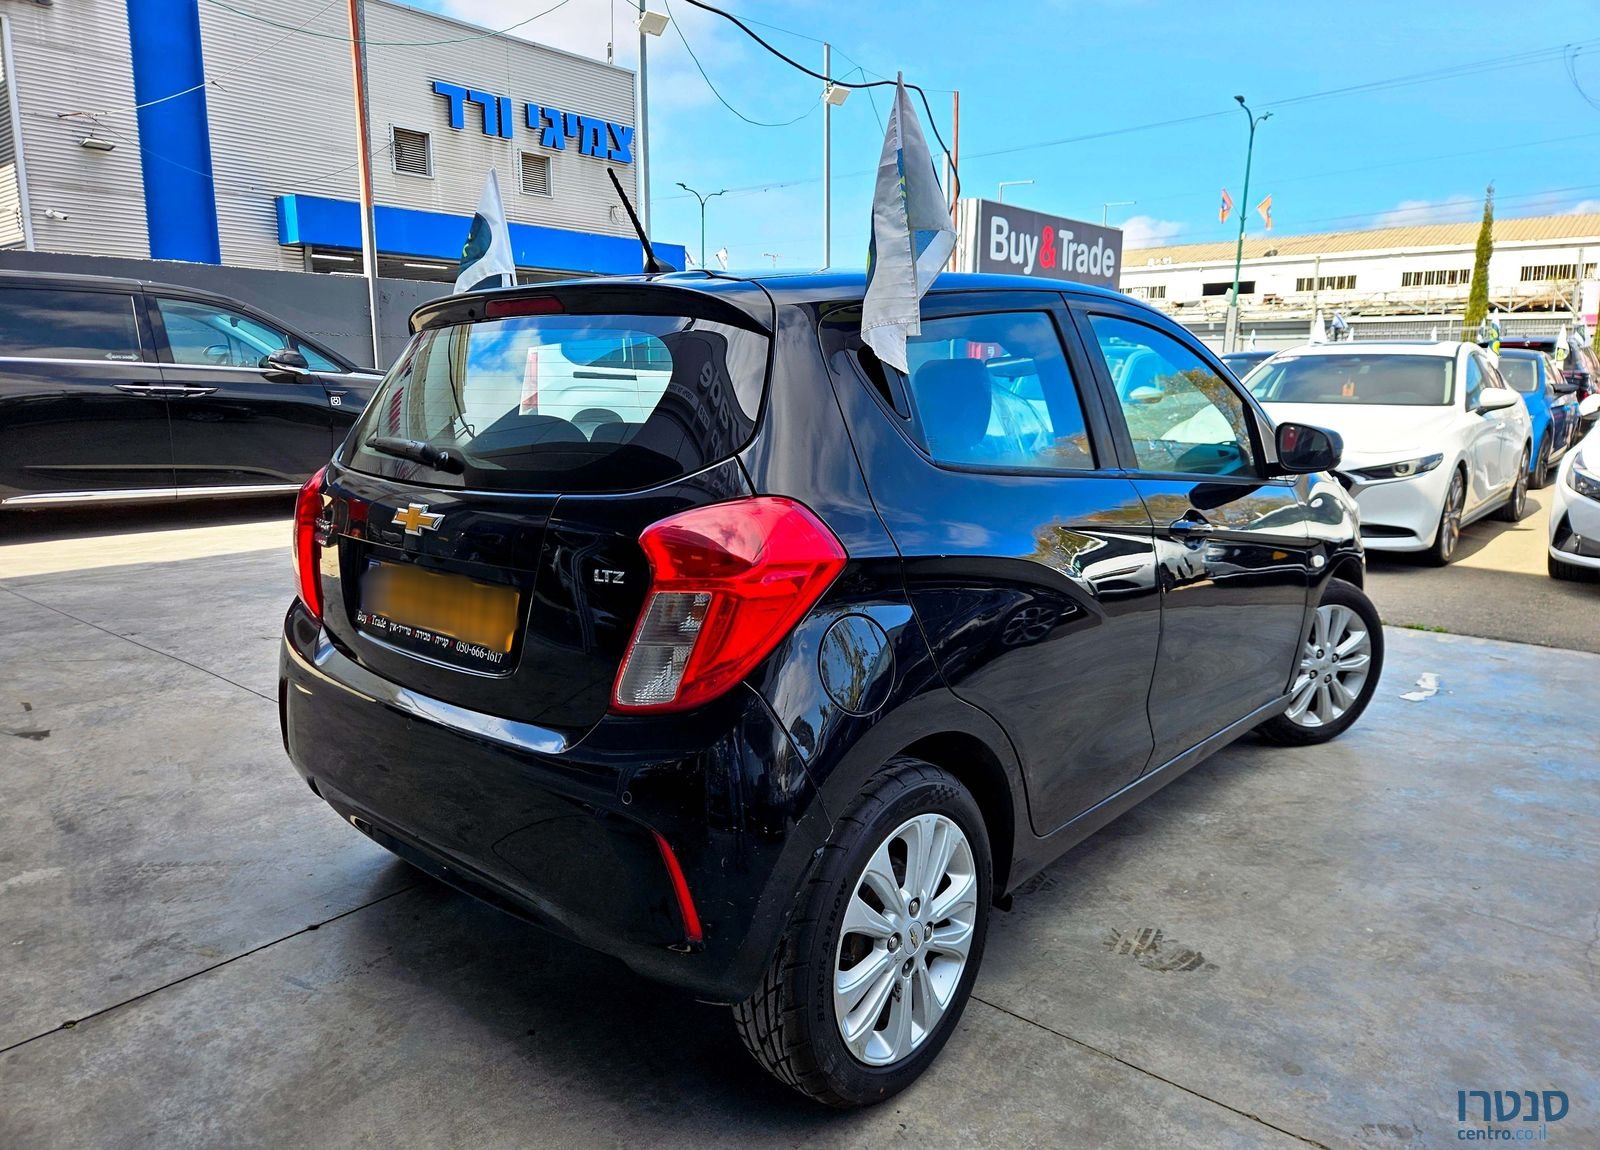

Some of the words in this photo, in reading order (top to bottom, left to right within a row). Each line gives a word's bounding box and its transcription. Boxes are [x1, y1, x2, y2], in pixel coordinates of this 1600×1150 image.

[432, 80, 513, 140] ורד
[525, 102, 634, 164] צמיגי
[594, 569, 625, 584] LTZ
[456, 641, 502, 663] 050-666-1617
